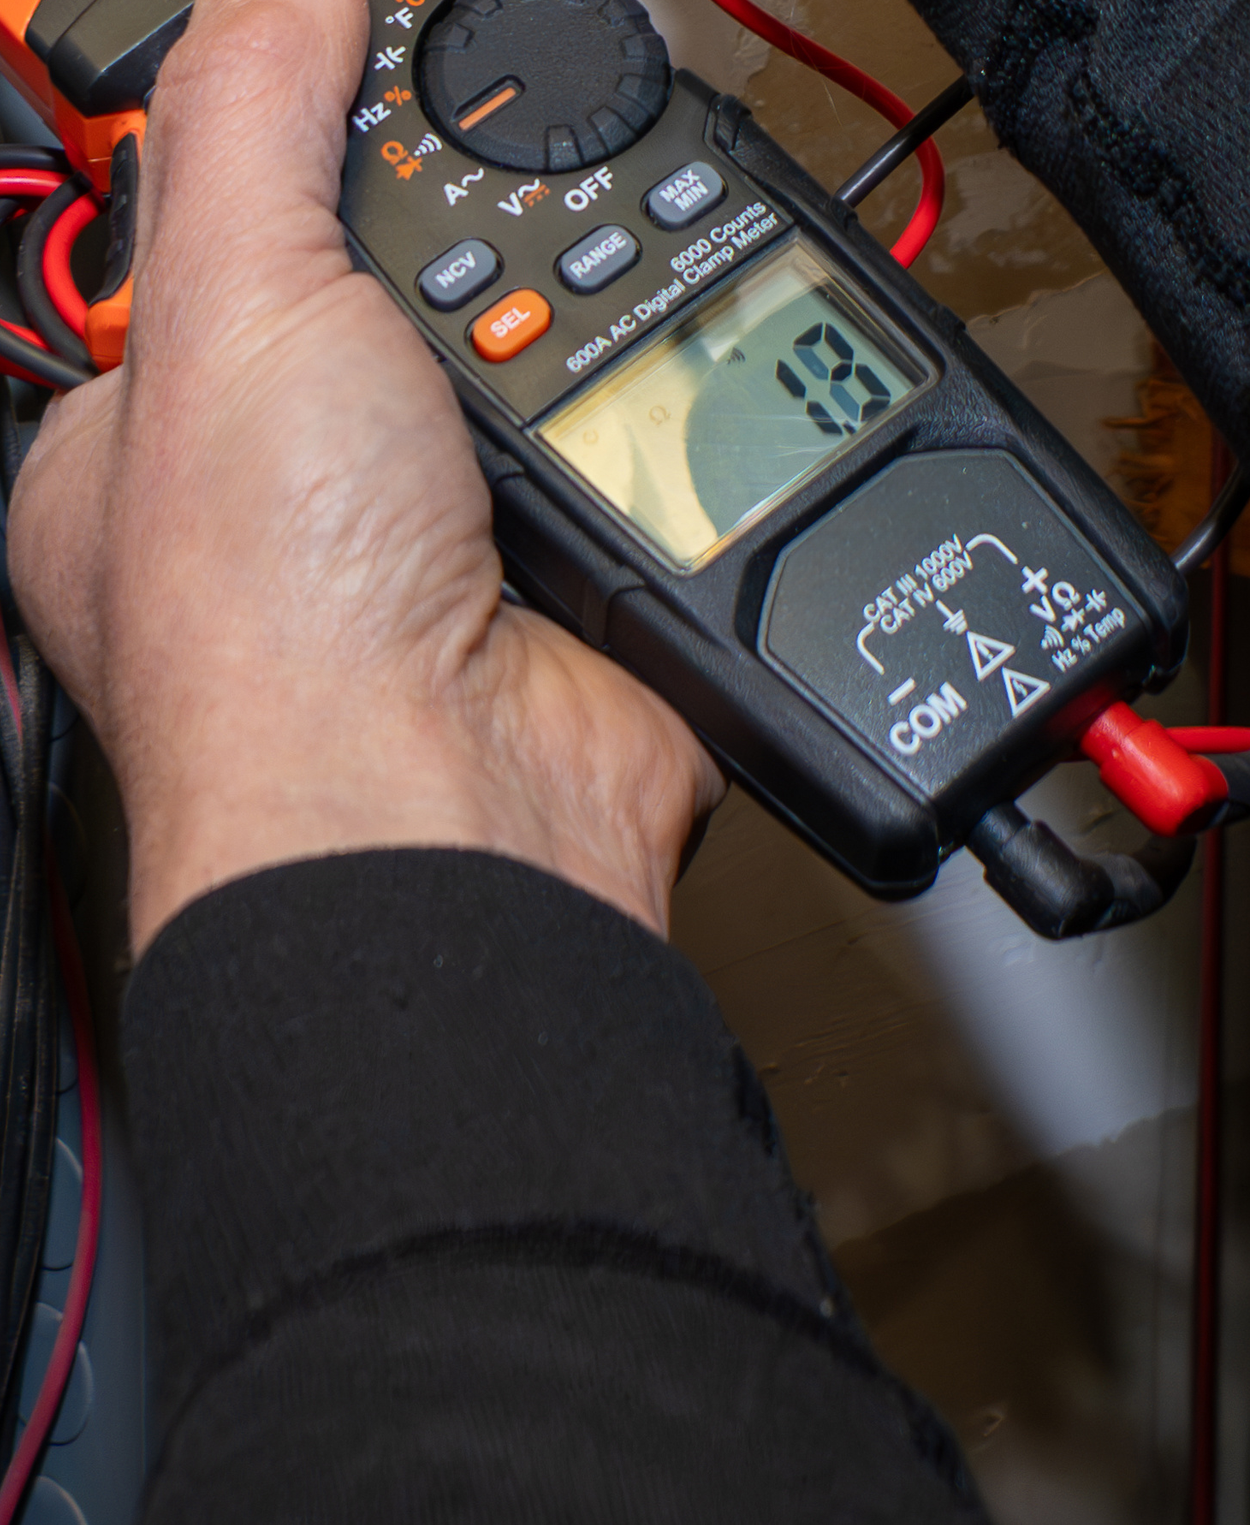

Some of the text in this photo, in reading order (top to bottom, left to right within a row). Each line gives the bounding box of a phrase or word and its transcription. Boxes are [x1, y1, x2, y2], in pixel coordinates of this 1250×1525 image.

[352, 85, 412, 132] Hz %
[564, 167, 613, 211] OFF
[659, 169, 702, 203] MAX
[674, 181, 708, 211] MIN
[569, 232, 627, 278] RANGE
[670, 202, 767, 273] 6000 Counts
[435, 252, 477, 288] NCV
[566, 213, 779, 373] 600A AC Digital Clamp Meter
[490, 308, 530, 337] SEL
[863, 533, 962, 623] CAT III 1000V
[880, 550, 973, 634] CAT IV 600V
[1052, 649, 1077, 672] Hz
[1084, 608, 1125, 643] Temp
[889, 682, 967, 755] COM
